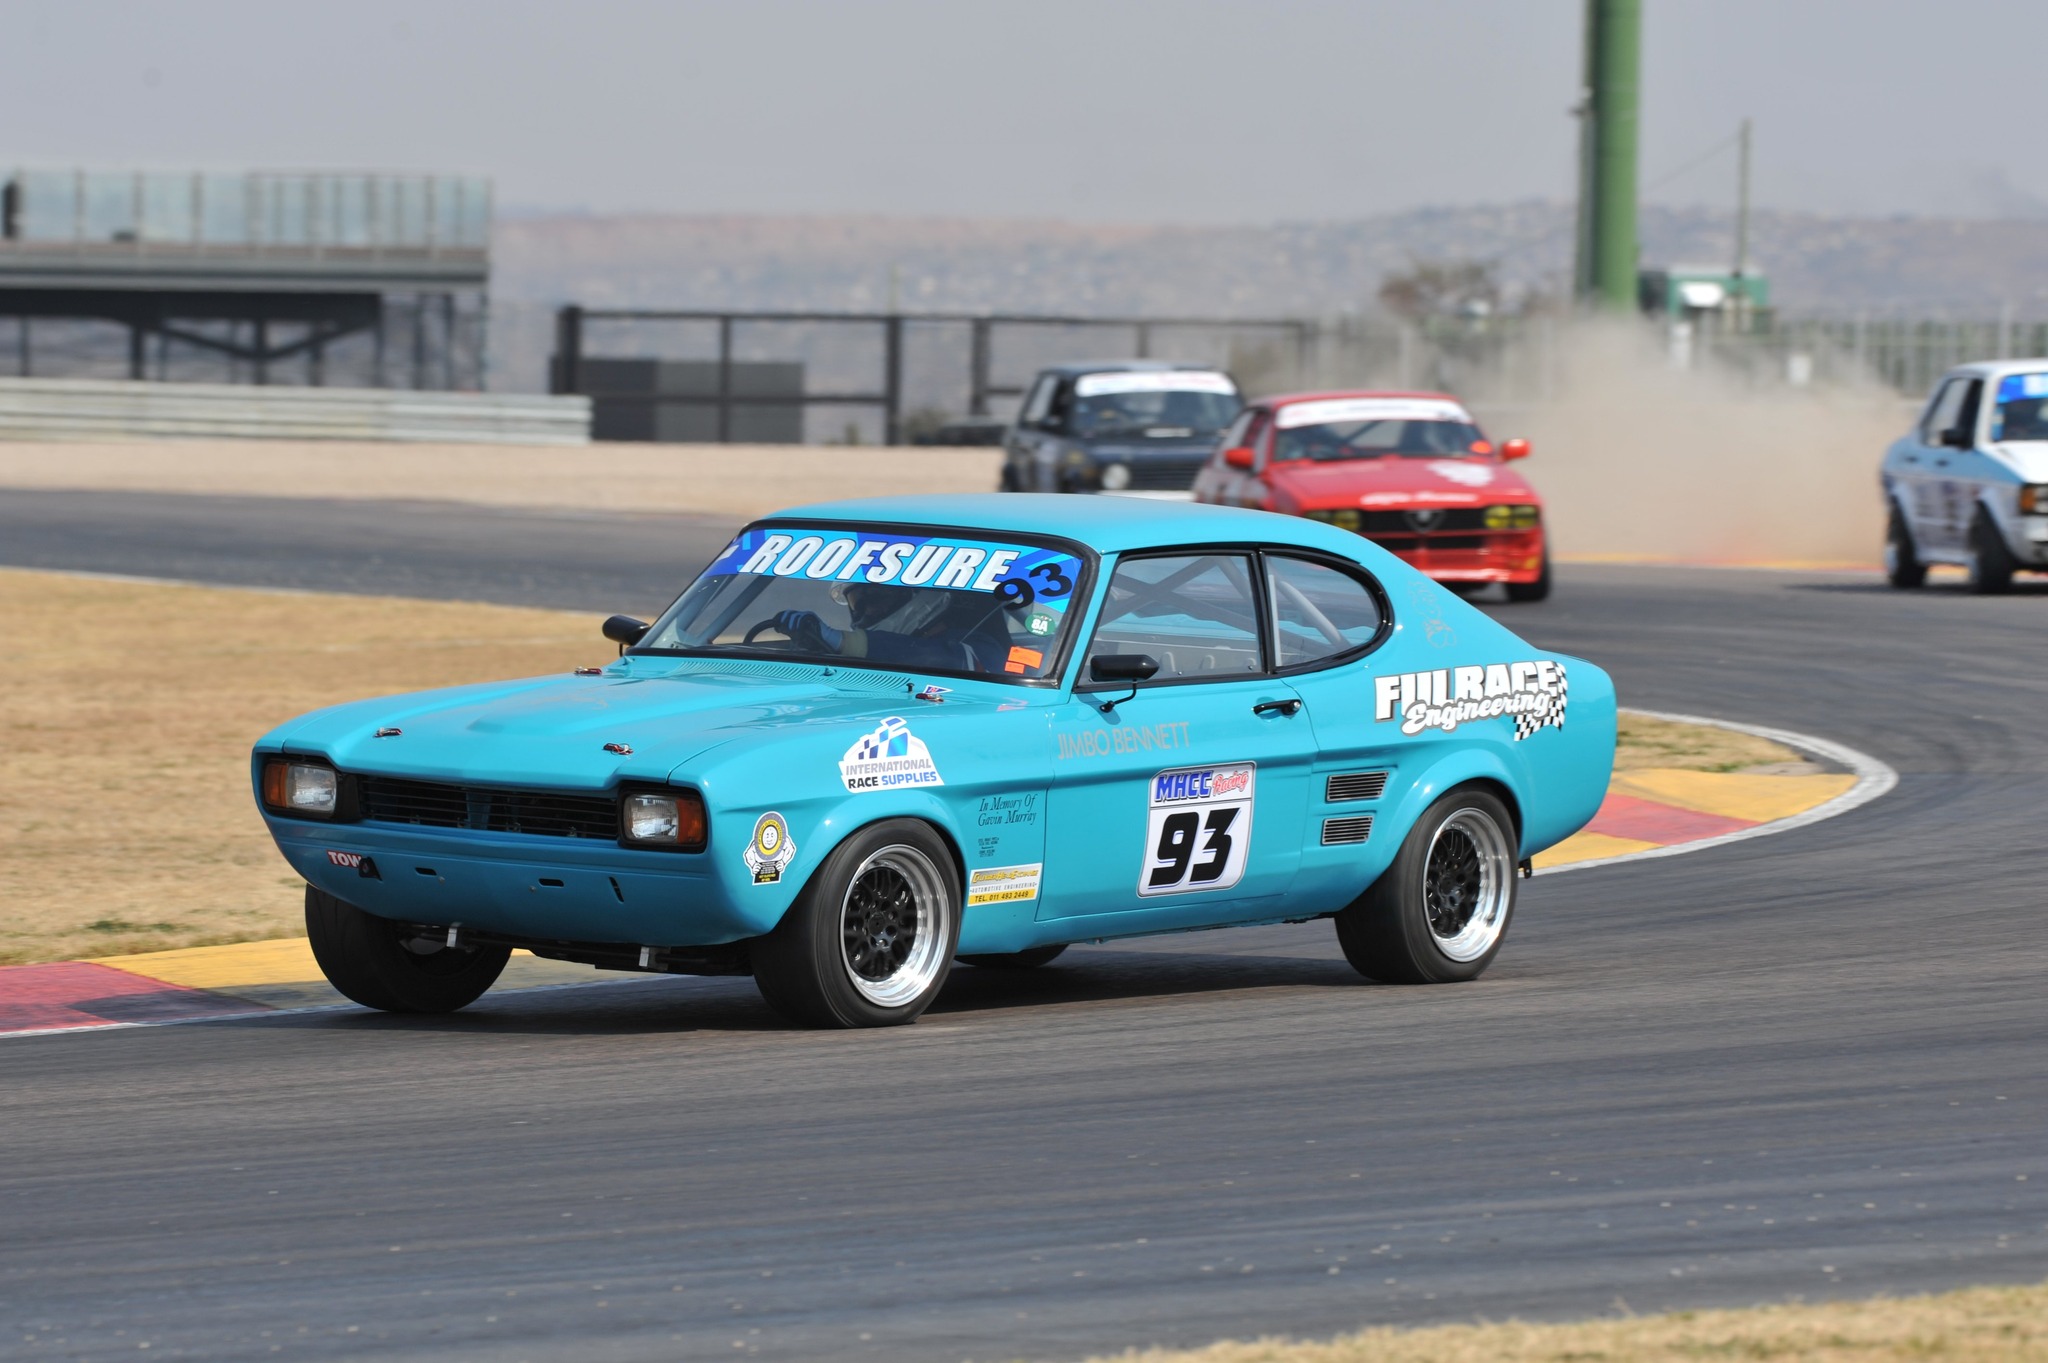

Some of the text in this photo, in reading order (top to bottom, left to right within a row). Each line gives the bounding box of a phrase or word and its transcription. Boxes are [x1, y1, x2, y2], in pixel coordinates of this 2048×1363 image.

[739, 533, 1020, 592] ROOFSURE
[994, 563, 1072, 610] 93
[1031, 618, 1048, 632] 8A
[1401, 693, 1551, 735] Engineering
[1058, 722, 1190, 760] JIMBO BENNETT
[846, 759, 931, 775] INTERNATIONAL
[848, 771, 937, 789] RACE SUPPLIES
[1155, 770, 1249, 802] MHCC Racing
[979, 793, 1038, 812] In Memory Of
[978, 810, 1037, 826] Gavin Murray
[327, 851, 362, 868] TOW
[1148, 807, 1242, 890] 93
